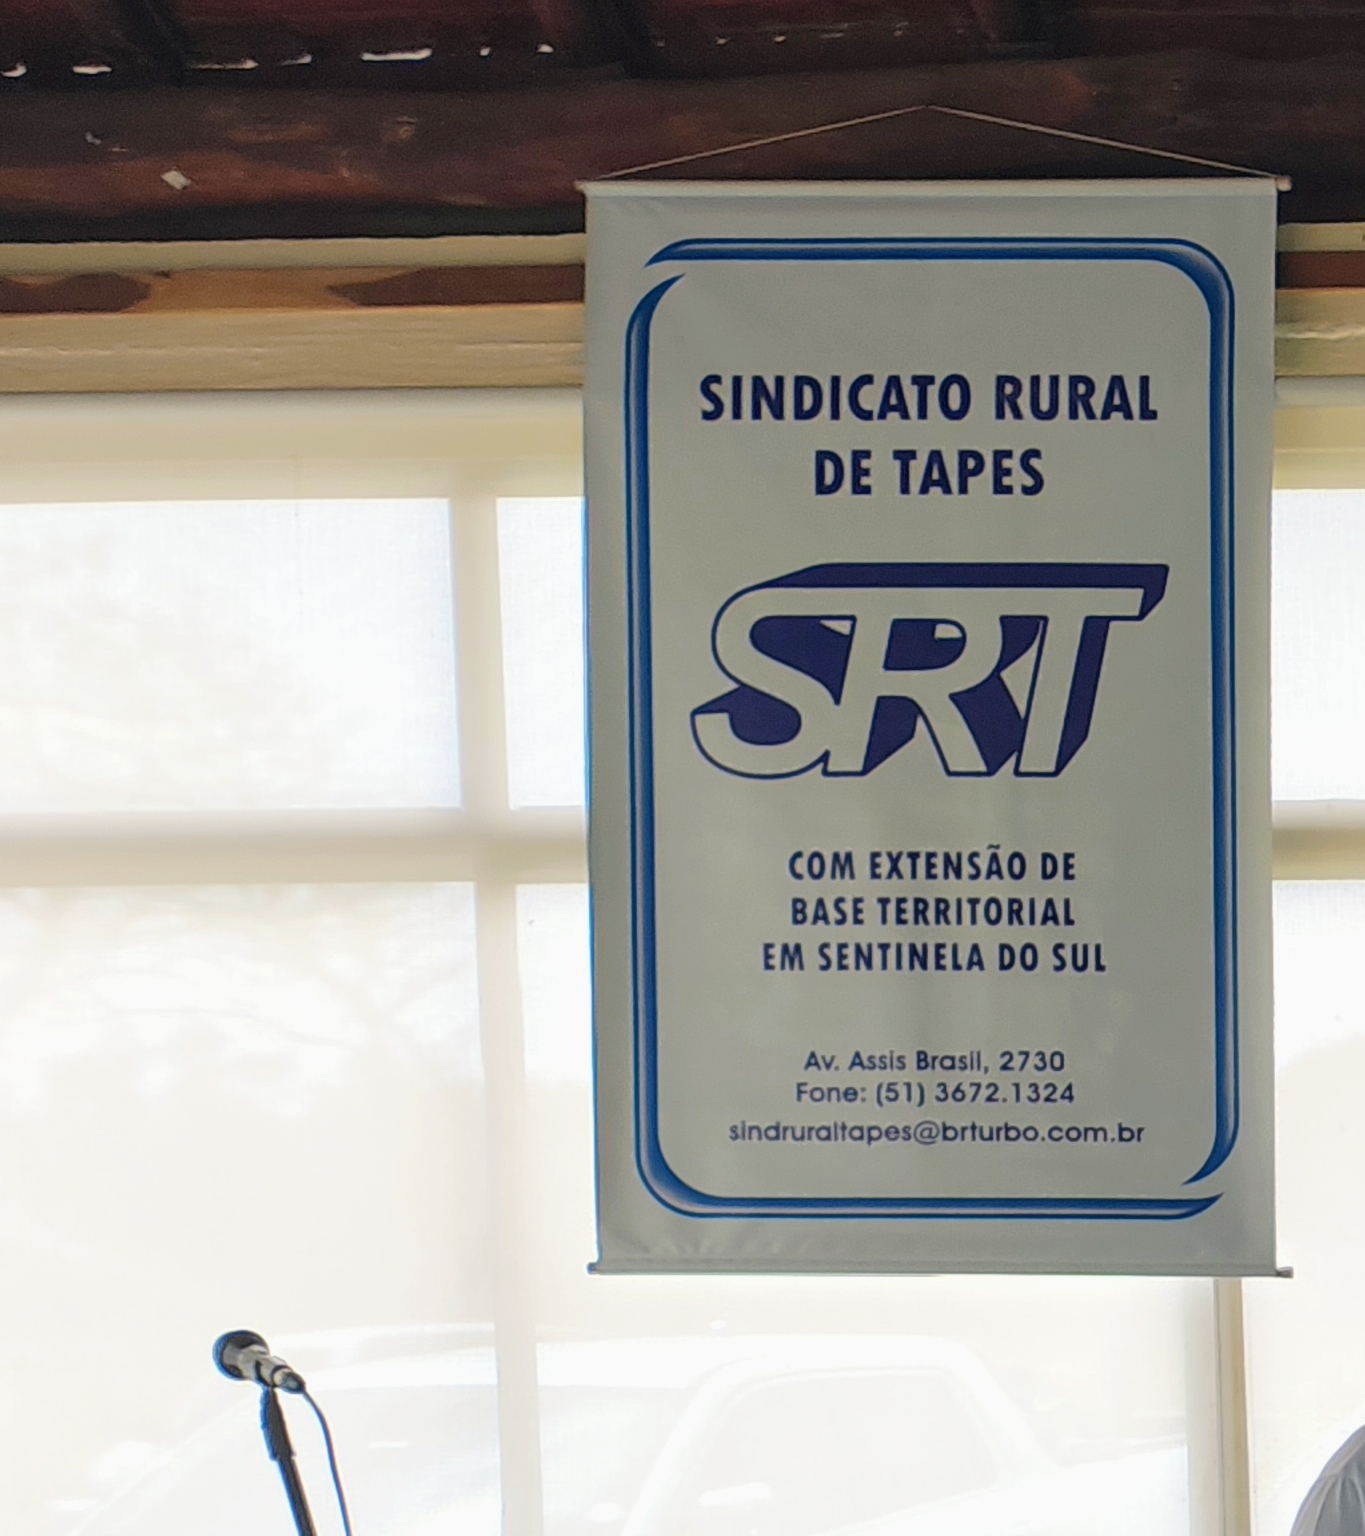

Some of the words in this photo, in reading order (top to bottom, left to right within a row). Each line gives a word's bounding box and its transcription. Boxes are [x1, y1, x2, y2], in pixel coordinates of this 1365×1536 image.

[700, 374, 971, 421] SINDICATO
[996, 375, 1157, 420] RURAL
[816, 450, 871, 495] DE
[893, 449, 1044, 495] TAPES
[691, 562, 1169, 779] SRT
[789, 851, 855, 879] COM
[871, 845, 1026, 880] EXTENSÃO
[1042, 853, 1075, 880] DE
[792, 897, 864, 925] BASE
[878, 897, 1075, 925] TERRITORIAL
[764, 943, 804, 970] EM
[819, 943, 984, 971] SENTINELA
[999, 943, 1038, 971] DO
[1053, 943, 1105, 972] SUL
[805, 1051, 838, 1070] Av.
[848, 1050, 906, 1072] Assis
[916, 1050, 989, 1076] Brasil,
[1000, 1051, 1064, 1071] 2730
[797, 1082, 865, 1102] Fone:
[877, 1082, 924, 1107] (51)
[935, 1083, 1074, 1103] 3672.1324
[729, 1120, 1146, 1147] sindruraltapes@brturbo.com.br
